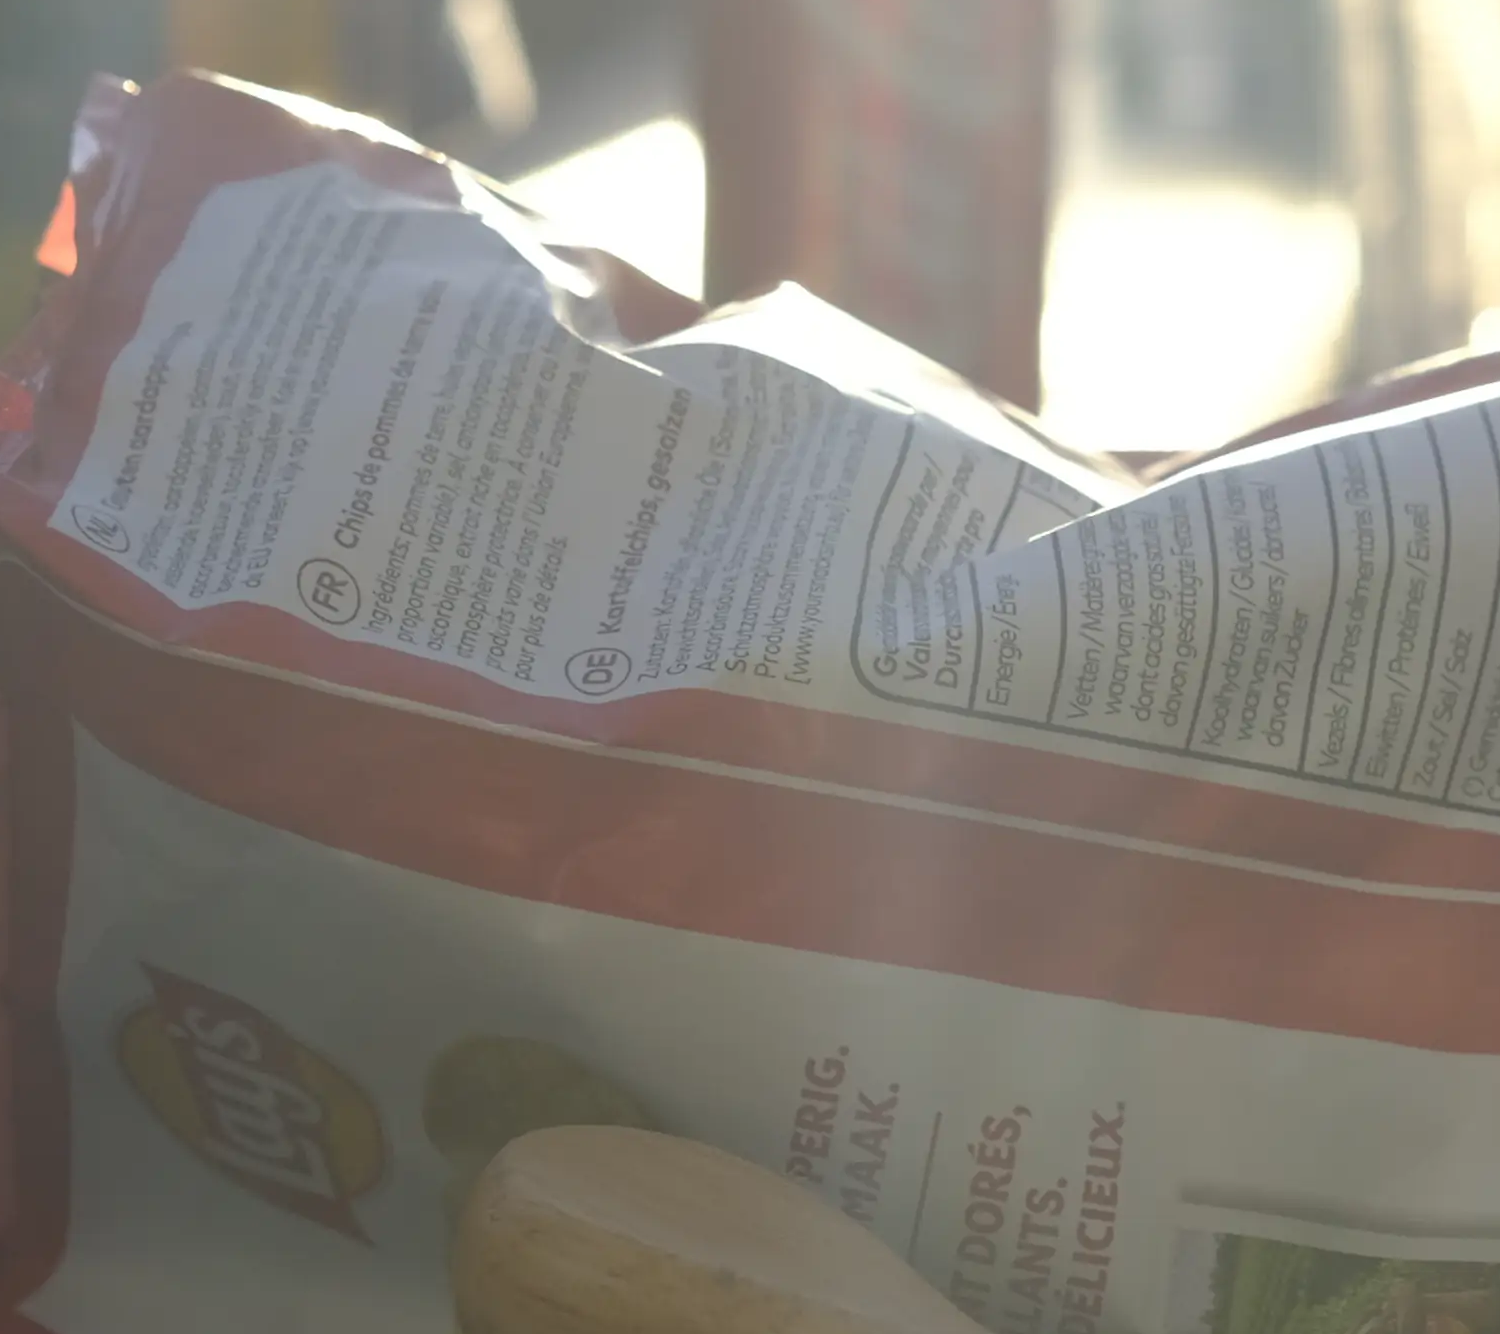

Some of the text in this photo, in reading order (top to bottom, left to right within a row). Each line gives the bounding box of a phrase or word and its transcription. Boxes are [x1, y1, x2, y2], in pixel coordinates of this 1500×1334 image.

[365, 378, 408, 463] pommes
[415, 441, 440, 465] de
[352, 459, 383, 487] de
[398, 465, 433, 537] pommes
[84, 515, 117, 543] NL
[332, 485, 379, 552] Chips
[596, 384, 692, 639] Kartoffelchips, gesalzen
[310, 568, 350, 613] FR
[397, 554, 436, 645] proportion
[503, 567, 529, 607] varie
[531, 591, 552, 613] de
[513, 645, 538, 682] pour
[523, 613, 546, 647] plus
[1139, 599, 1167, 668] acides
[1234, 645, 1273, 743] waarvan
[1255, 575, 1287, 644] suikers
[1329, 622, 1363, 687] Fibres
[581, 648, 618, 690] DE
[985, 625, 1025, 707] Energie
[1066, 646, 1103, 722] Vetten
[1103, 620, 1135, 717] waarvan
[1128, 666, 1158, 723] dont
[1154, 657, 1189, 728] davon
[1259, 605, 1310, 748] davon Zucker
[1317, 702, 1350, 769] Vezels
[1411, 737, 1446, 789] Zout
[1430, 689, 1460, 724] Sel
[785, 1045, 850, 1184] PERIG.
[839, 1082, 900, 1222] MAAK.
[956, 1104, 1033, 1271] DORÉS,
